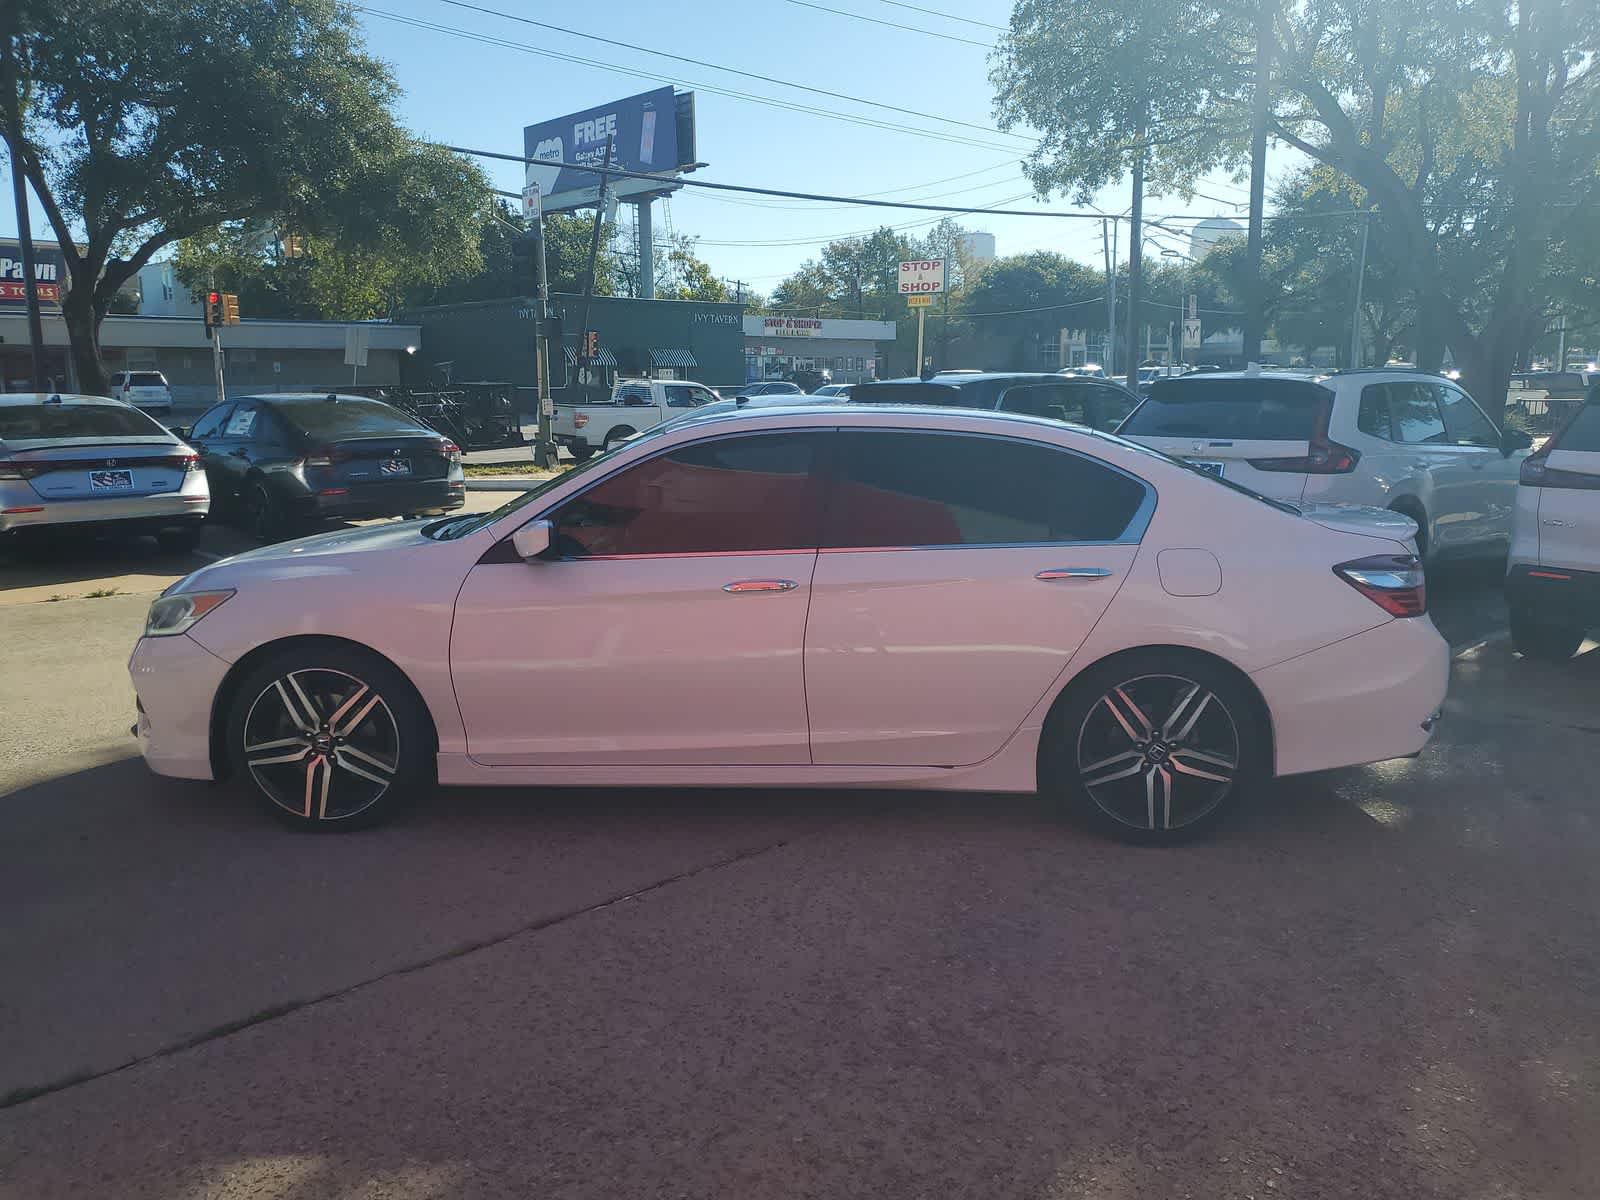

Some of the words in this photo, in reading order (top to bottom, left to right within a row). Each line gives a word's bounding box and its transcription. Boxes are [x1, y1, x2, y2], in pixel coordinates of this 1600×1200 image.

[574, 113, 617, 145] FREE
[902, 261, 941, 271] STOP
[11, 286, 54, 297] TOLS
[901, 282, 941, 292] SHOP
[694, 312, 709, 323] IVY
[710, 313, 738, 325] TAVERN
[765, 318, 785, 328] STOP
